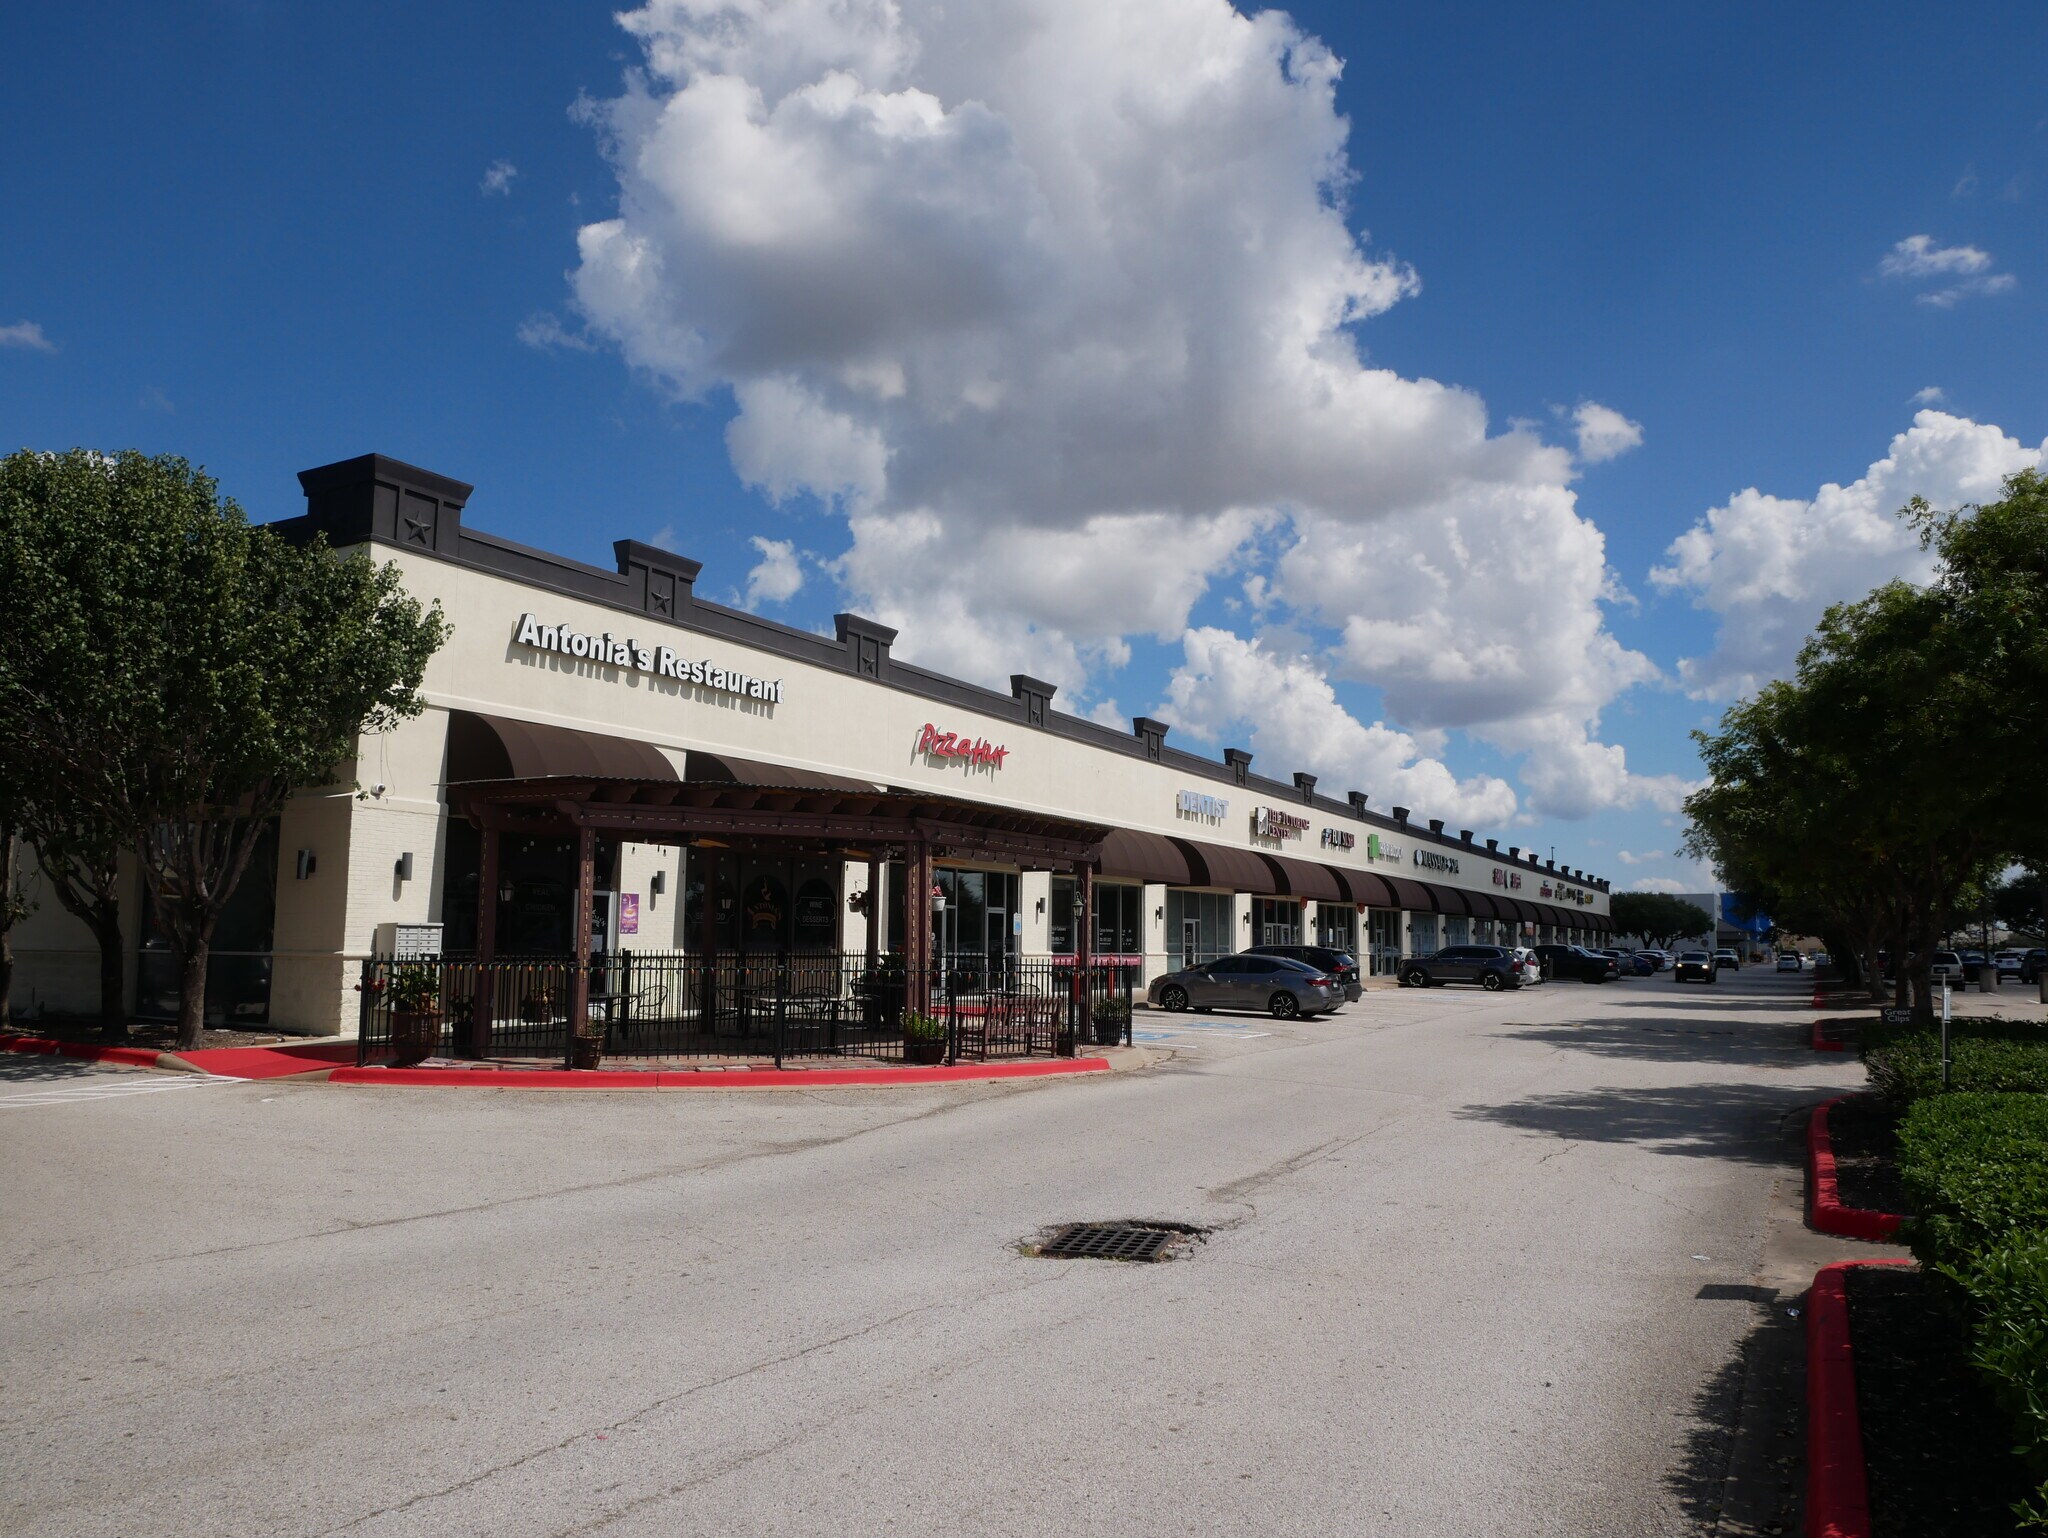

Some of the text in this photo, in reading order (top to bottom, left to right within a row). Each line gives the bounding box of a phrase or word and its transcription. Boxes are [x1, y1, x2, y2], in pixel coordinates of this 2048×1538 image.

[516, 613, 785, 704] Antonia's Restaurant
[971, 737, 1010, 770] Hut
[1179, 789, 1229, 819] DENTIST
[1268, 808, 1282, 823] THE
[1268, 823, 1290, 840] CENTER
[802, 915, 829, 923] DESSERTS
[1884, 1008, 1911, 1016] Great
[1887, 1015, 1911, 1023] Clips
